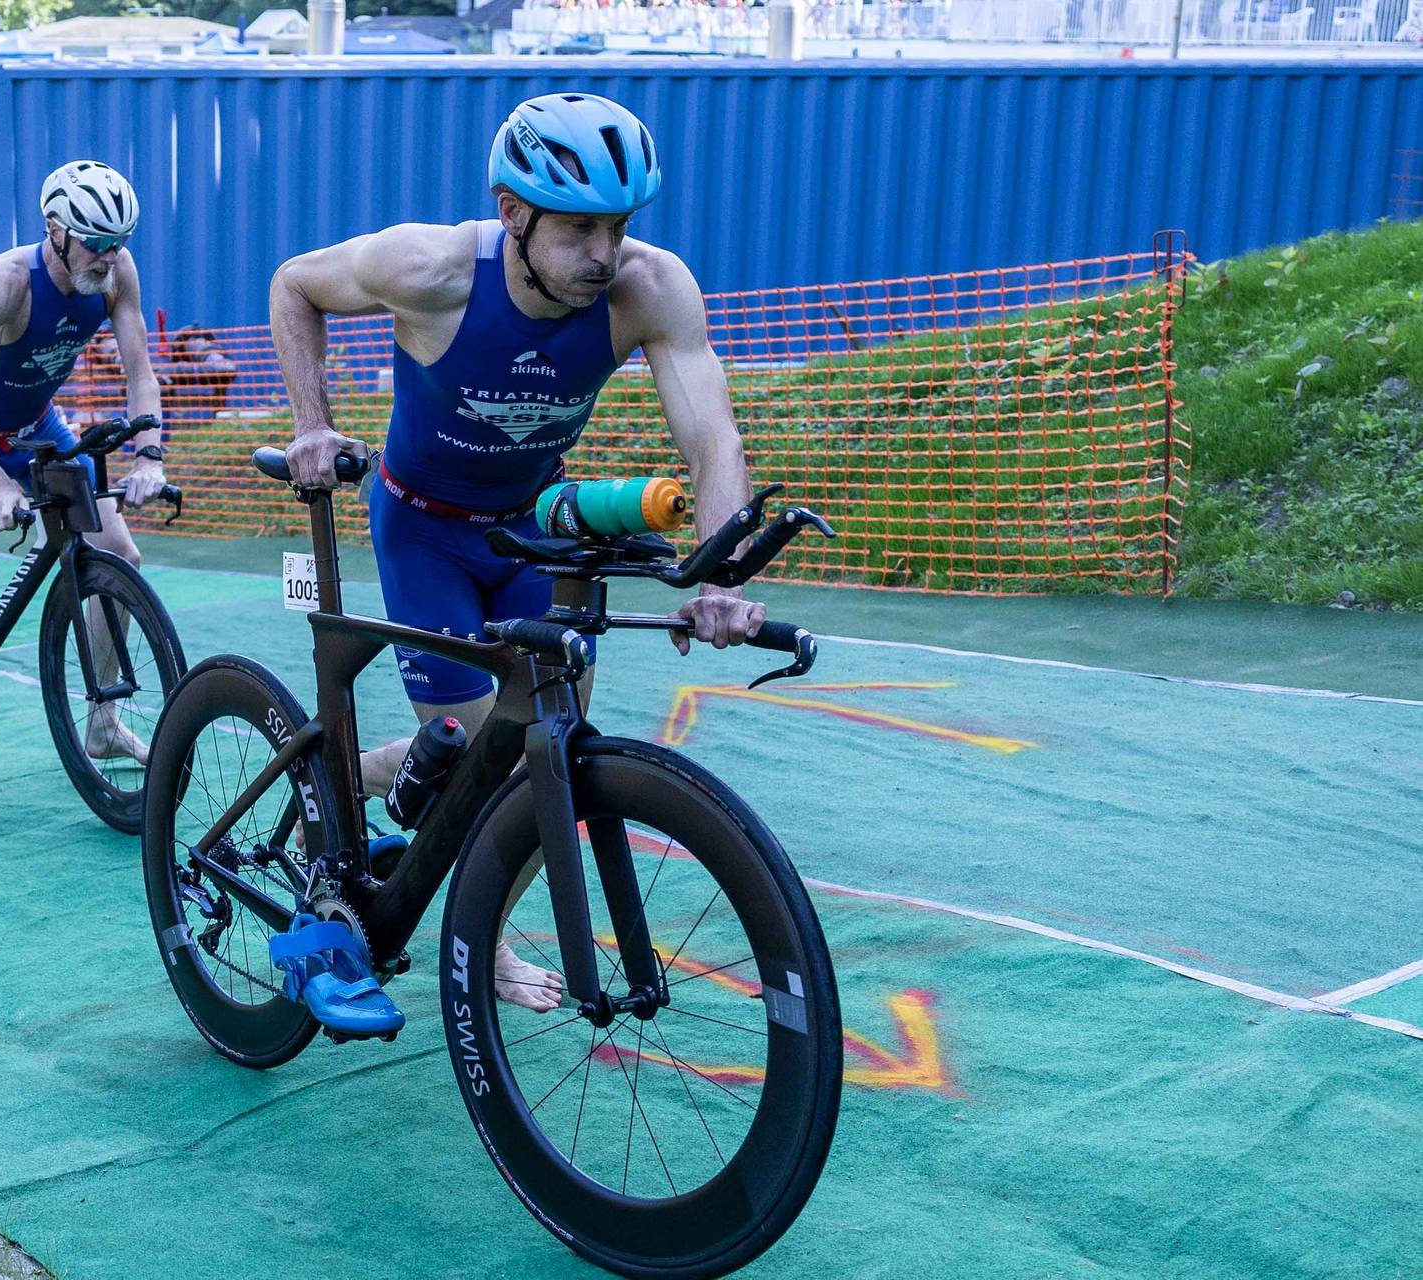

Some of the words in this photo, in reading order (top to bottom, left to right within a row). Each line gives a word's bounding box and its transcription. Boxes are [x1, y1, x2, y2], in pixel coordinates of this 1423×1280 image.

[514, 120, 545, 151] MET
[511, 364, 556, 378] skinfit
[460, 387, 595, 405] TRIATHLON
[287, 578, 320, 602] 1003
[297, 780, 321, 822] DT
[452, 935, 470, 994] DT
[454, 1000, 491, 1097] SWISS
